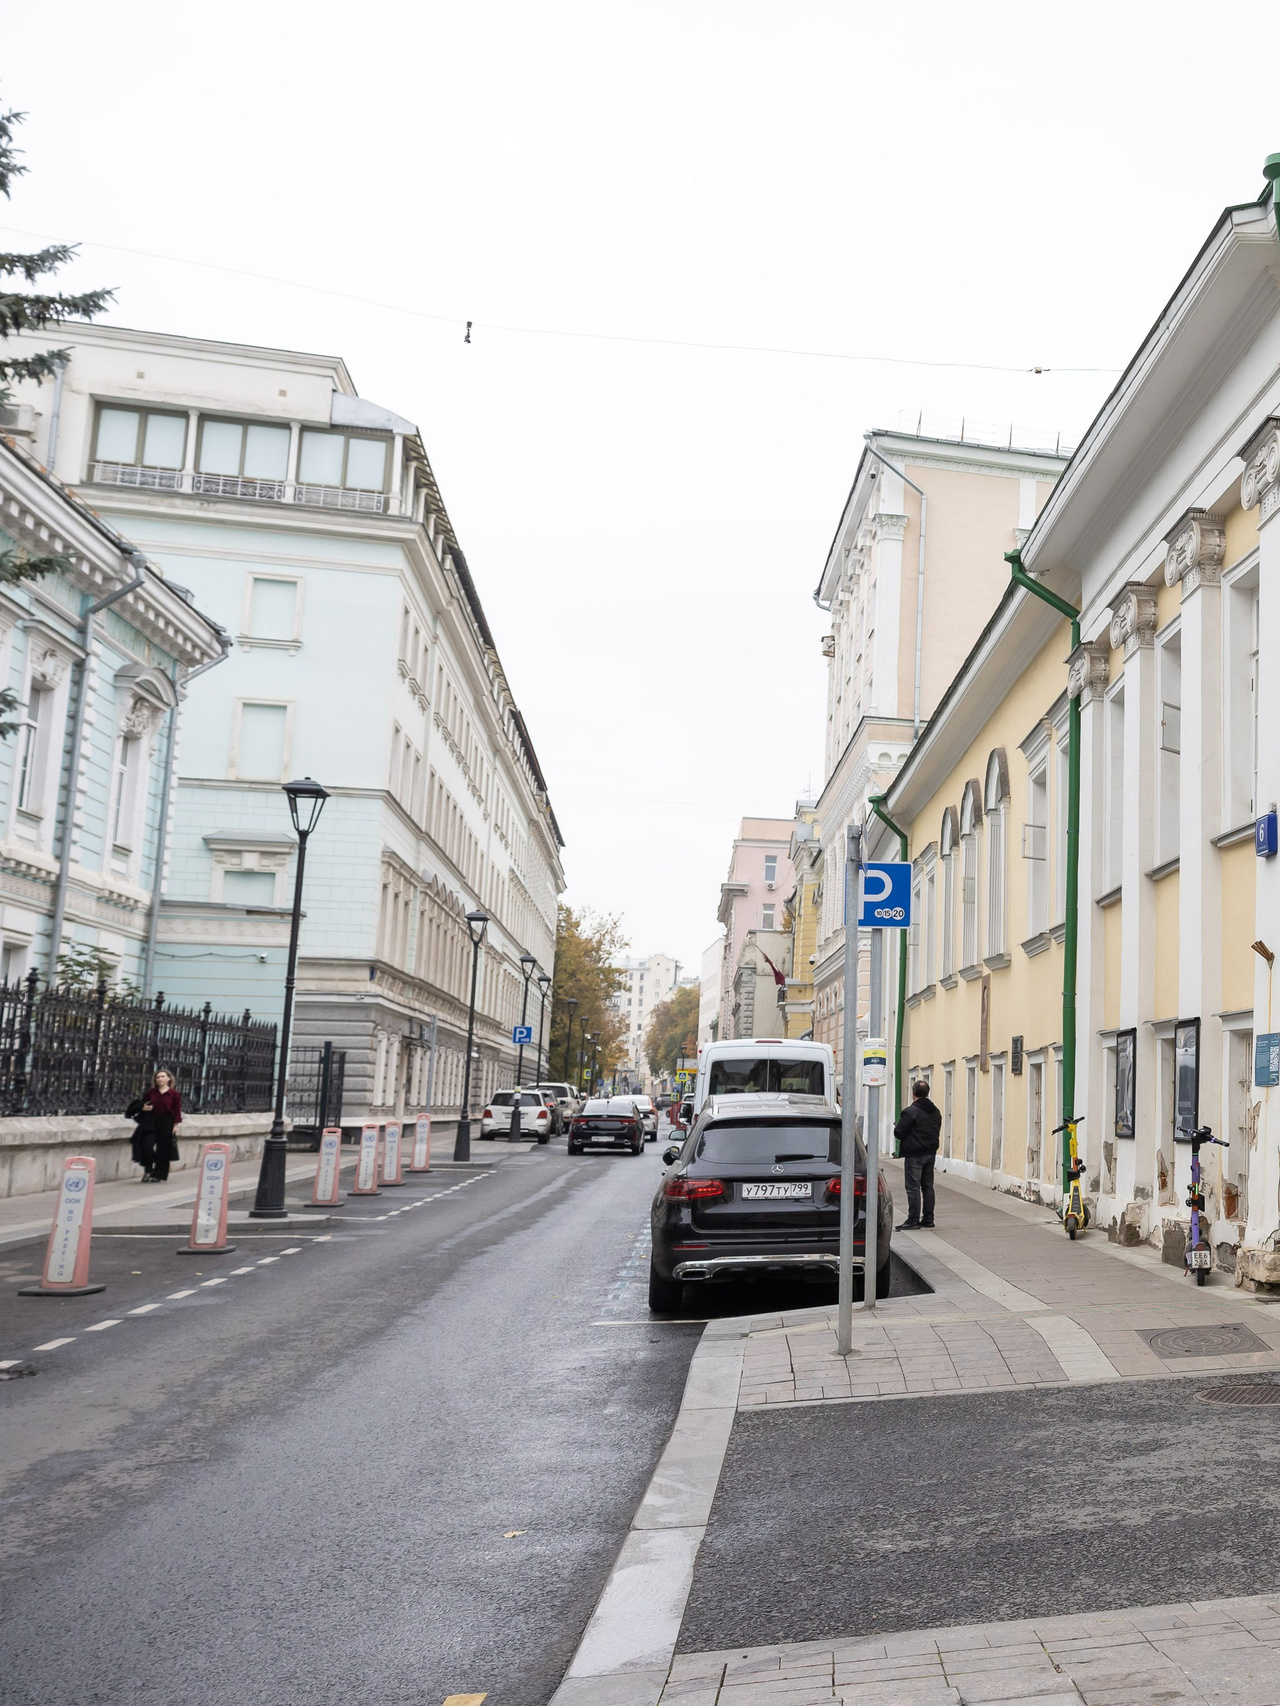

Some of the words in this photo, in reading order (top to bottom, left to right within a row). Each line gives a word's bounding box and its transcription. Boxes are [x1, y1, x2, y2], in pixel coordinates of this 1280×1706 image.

[1260, 824, 1265, 842] 6
[858, 869, 893, 919] P
[515, 1028, 527, 1043] P
[746, 1184, 789, 1196] У797ТУ
[792, 1183, 809, 1192] 799
[66, 1209, 74, 1222] NO
[57, 1229, 70, 1277] PARKING
